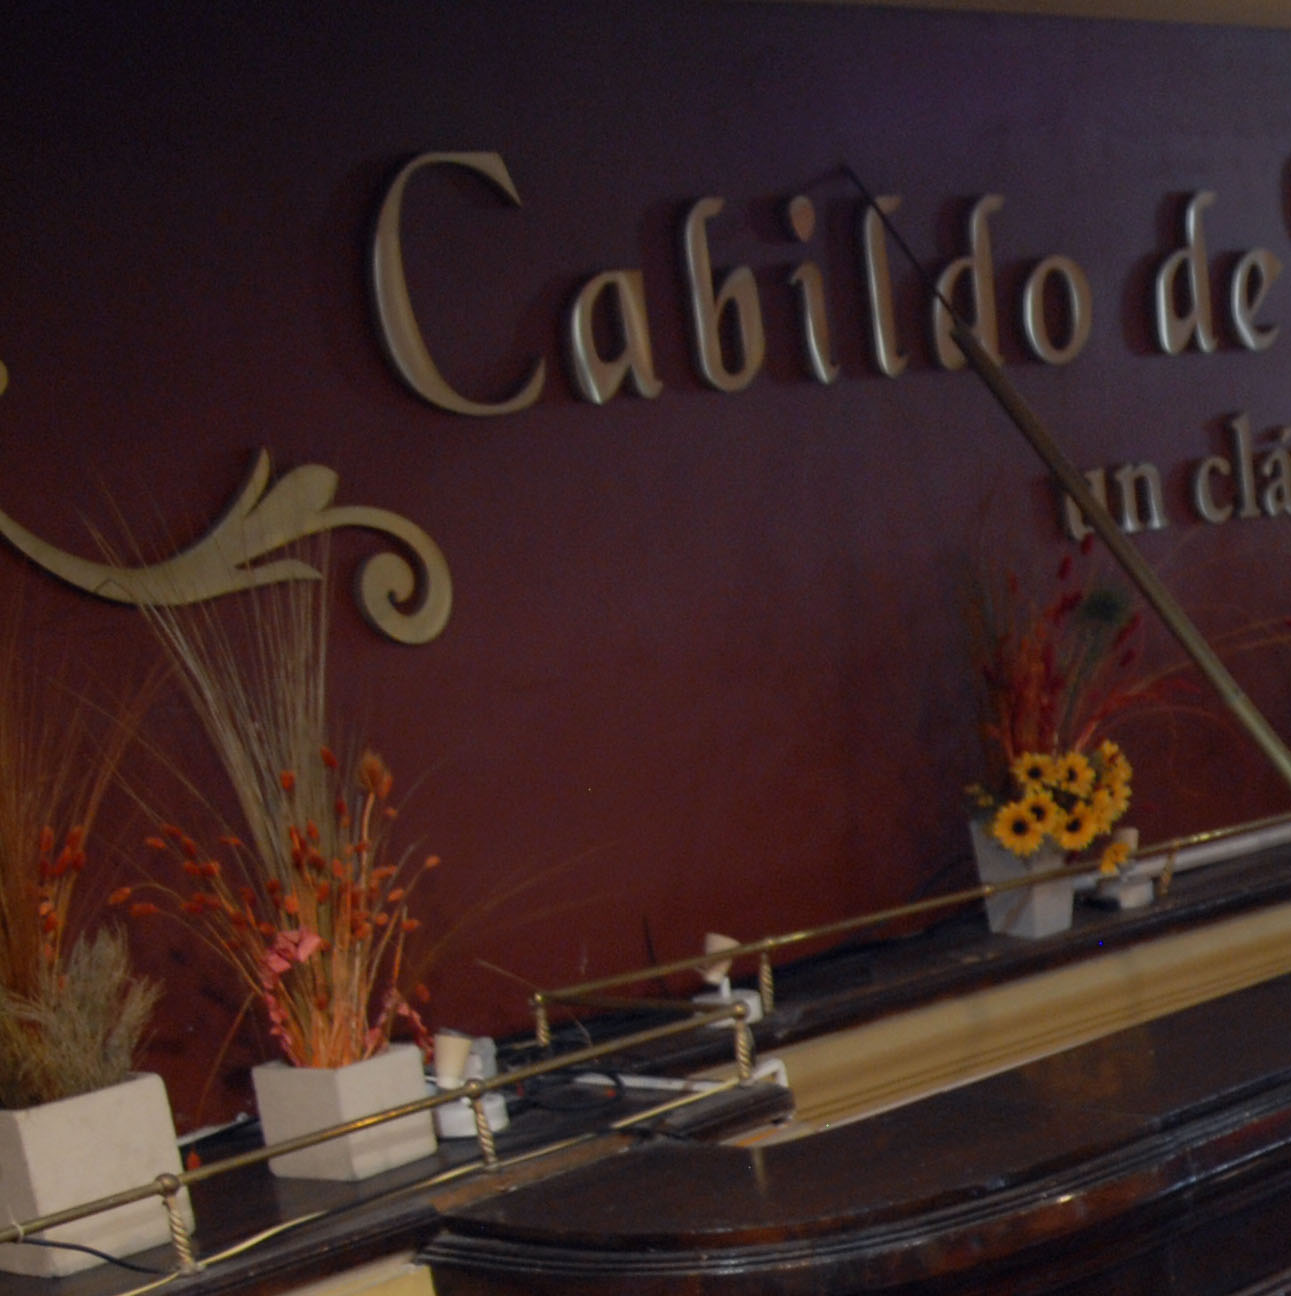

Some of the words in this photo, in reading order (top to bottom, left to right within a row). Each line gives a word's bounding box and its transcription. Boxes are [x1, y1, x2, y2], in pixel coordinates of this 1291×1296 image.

[372, 151, 1093, 415] Cabildo
[1156, 191, 1282, 356] de
[1063, 459, 1166, 541] un
